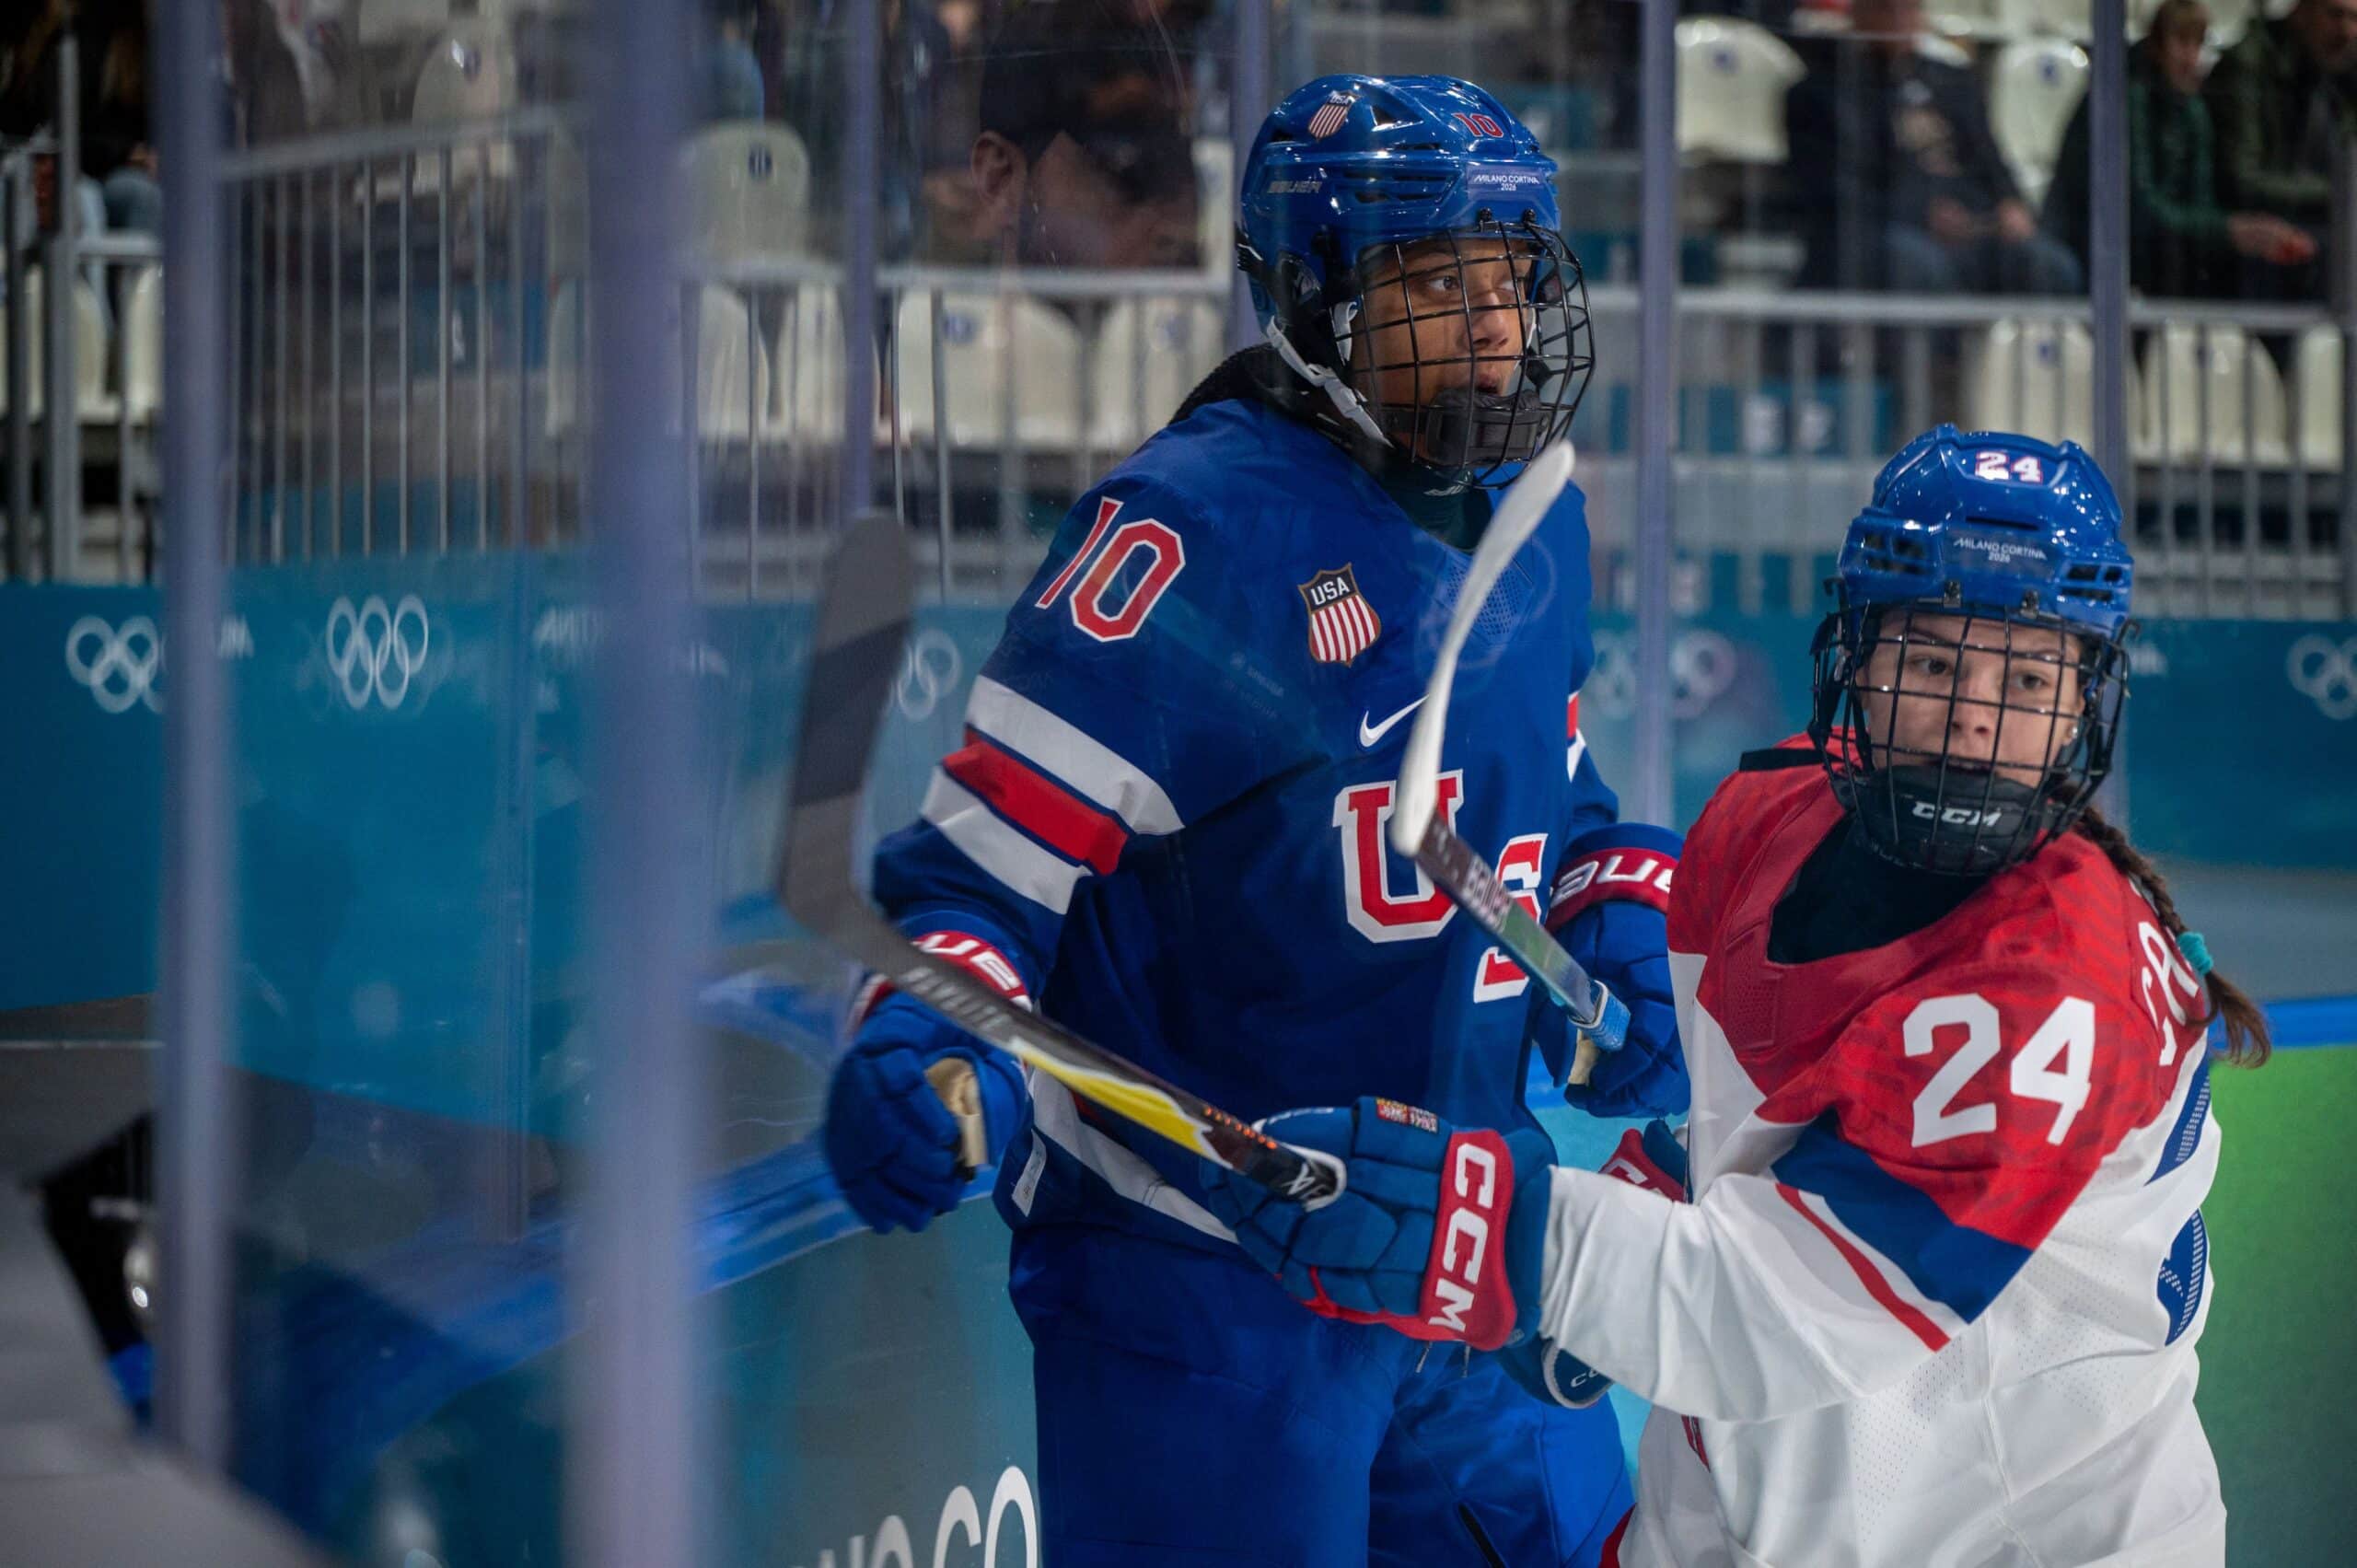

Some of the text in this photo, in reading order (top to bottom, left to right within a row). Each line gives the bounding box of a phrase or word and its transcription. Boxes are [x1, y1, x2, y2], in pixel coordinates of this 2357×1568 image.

[1451, 112, 1504, 138] 10
[1473, 174, 1540, 184] MILANO CORTINA
[1501, 183, 1517, 192] 2026
[1975, 450, 2043, 483] 24
[1953, 538, 2048, 561] MILANO CORTINA
[1035, 495, 1186, 643] 10
[1310, 576, 1350, 606] USA
[1911, 801, 2003, 828] CCM
[1902, 993, 2096, 1148] 24
[1428, 1142, 1496, 1333] CCM
